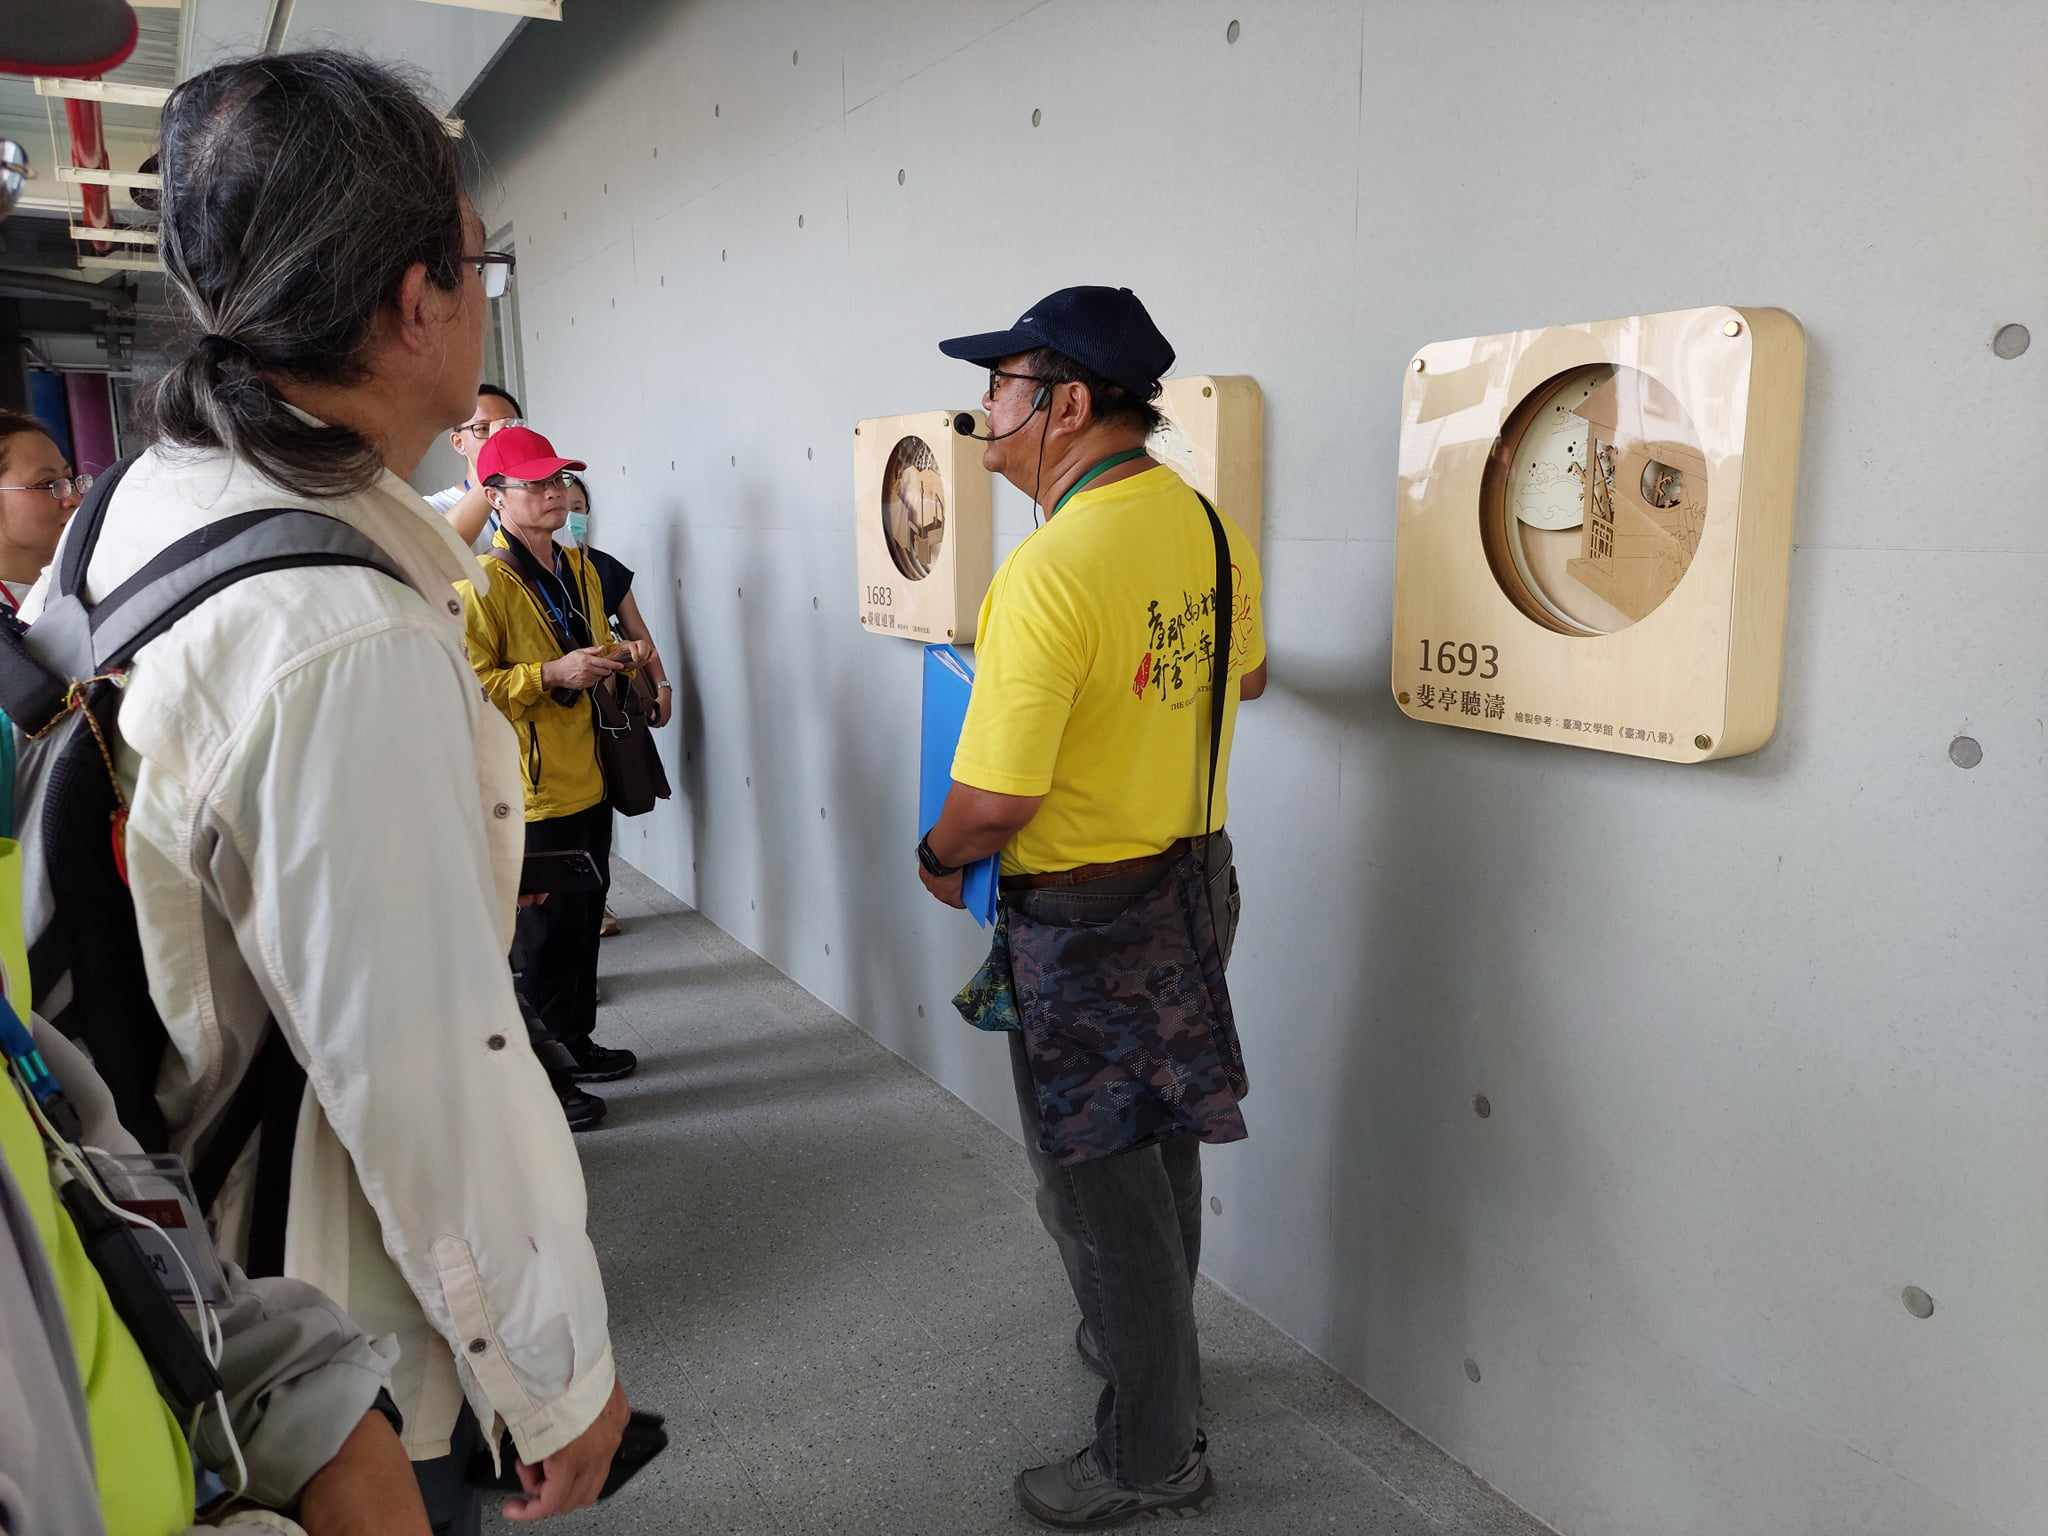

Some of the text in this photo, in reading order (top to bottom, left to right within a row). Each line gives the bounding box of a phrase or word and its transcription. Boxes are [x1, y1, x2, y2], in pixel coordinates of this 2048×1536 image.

[866, 585, 892, 606] 1683
[1418, 639, 1500, 679] 1693
[1415, 683, 1506, 720] 斐亭聽濤
